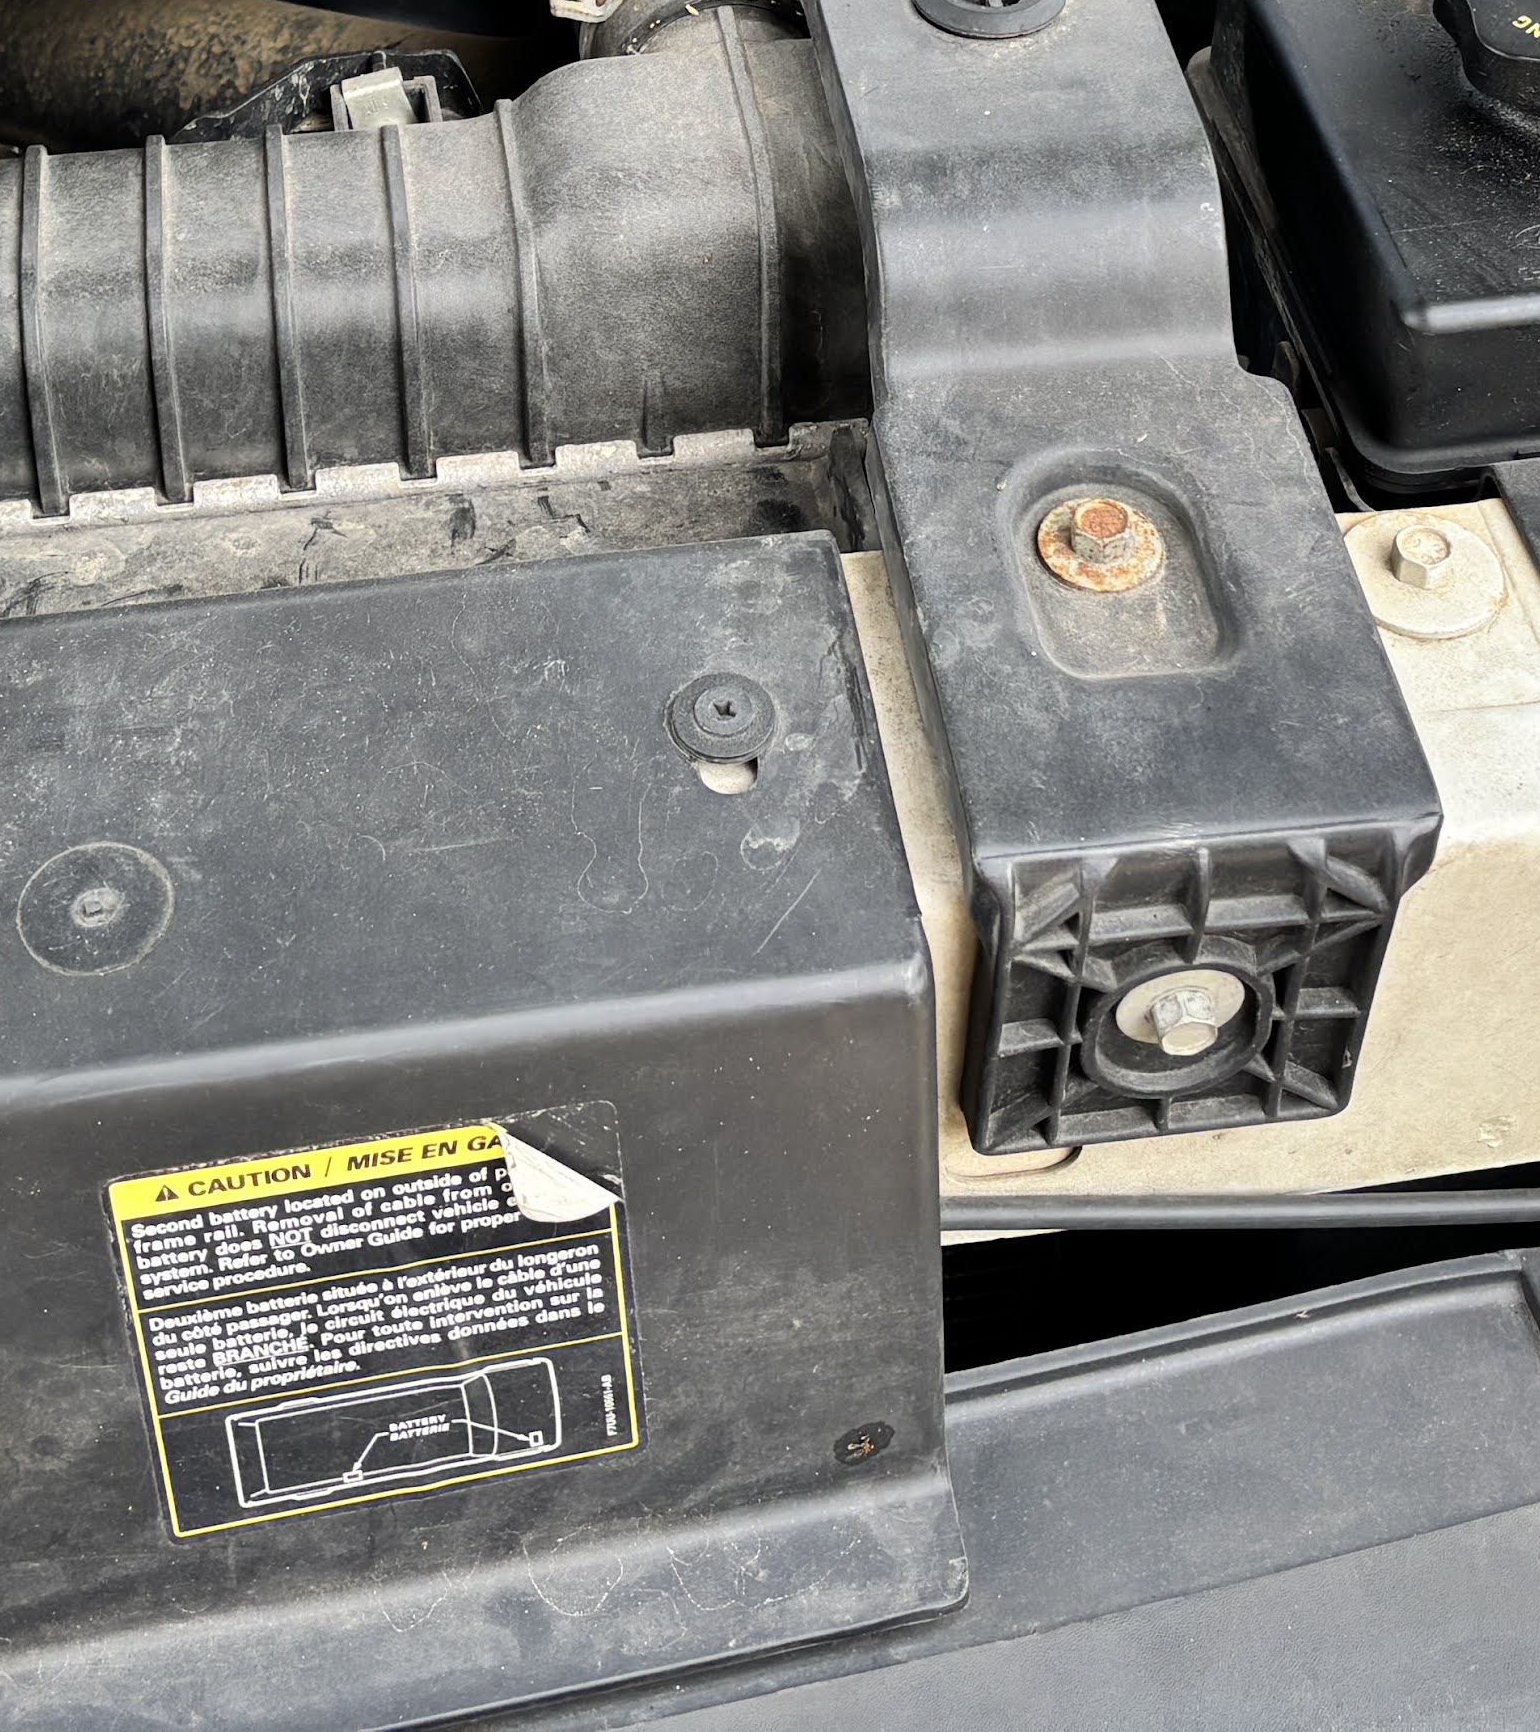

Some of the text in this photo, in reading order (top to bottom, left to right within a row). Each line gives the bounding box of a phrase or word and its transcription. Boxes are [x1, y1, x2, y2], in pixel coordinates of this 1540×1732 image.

[188, 1164, 311, 1196] CAUTION
[347, 1147, 413, 1171] MISE
[421, 1140, 458, 1159] EN
[467, 1135, 502, 1151] GA
[130, 1213, 204, 1239] Second
[208, 1204, 278, 1227] battery
[283, 1188, 354, 1214] located
[360, 1186, 386, 1201] on
[391, 1173, 463, 1196] outside
[468, 1166, 488, 1183] of
[133, 1234, 197, 1255] frame
[203, 1223, 245, 1244] rail.
[251, 1206, 345, 1235] Removal
[351, 1201, 373, 1218] of
[380, 1193, 436, 1213] cable
[442, 1185, 493, 1203] from
[136, 1248, 208, 1270] battery
[214, 1238, 263, 1257] does
[268, 1226, 314, 1250] NOT
[320, 1209, 426, 1239] disconnect
[431, 1198, 500, 1220] vehicle
[139, 1211, 521, 1286] system. Refer to Owner Guide for proper
[142, 1262, 312, 1301] service procedure.
[148, 1306, 243, 1332] Deuxième
[245, 1291, 319, 1315] batterie
[321, 1281, 379, 1302] située
[381, 1278, 394, 1292] à
[489, 1257, 514, 1273] du
[517, 1244, 600, 1271] longeron
[152, 1331, 178, 1347] du
[180, 1321, 223, 1342] côté
[225, 1309, 313, 1336] passager.
[412, 1281, 472, 1302] enlève
[475, 1276, 494, 1290] le
[496, 1266, 546, 1286] câble
[154, 1272, 603, 1362] seule batterie, le circuit électrique du véhicule
[157, 1286, 604, 1376] reste BRANCHÉ. Pour toute intervention sur la
[159, 1301, 606, 1392] batterie, suivre les directives données dans le
[164, 1360, 361, 1405] Guide du propriétaire.
[388, 1414, 448, 1432] BATTERY
[388, 1423, 449, 1442] BATTERIE
